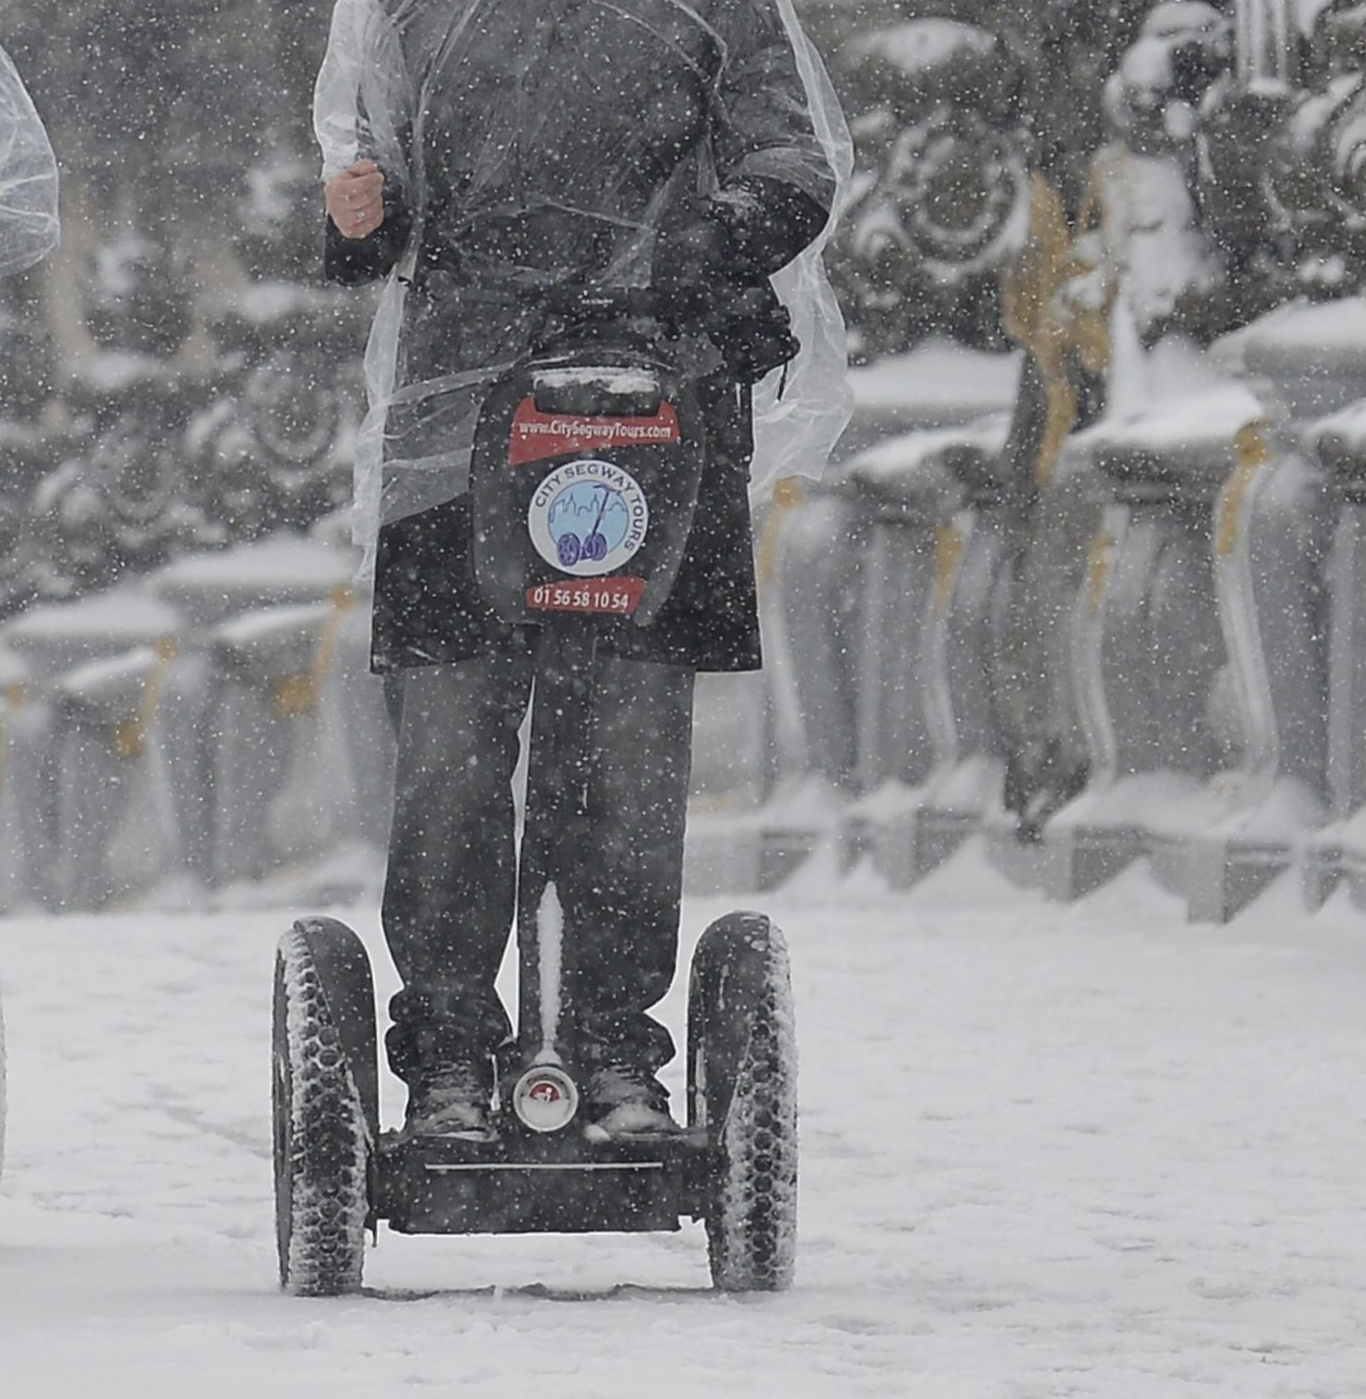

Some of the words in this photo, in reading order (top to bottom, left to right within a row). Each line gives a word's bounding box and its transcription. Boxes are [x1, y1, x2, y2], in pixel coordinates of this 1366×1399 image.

[519, 420, 672, 440] www.CitySegwayTours.com
[535, 474, 563, 508] CITY
[564, 463, 635, 492] SEGWAY
[624, 495, 645, 552] TOURS
[534, 589, 550, 603] 01
[554, 590, 571, 606] 56
[573, 591, 590, 607] 58
[593, 592, 609, 608] 10
[613, 593, 630, 608] 54
